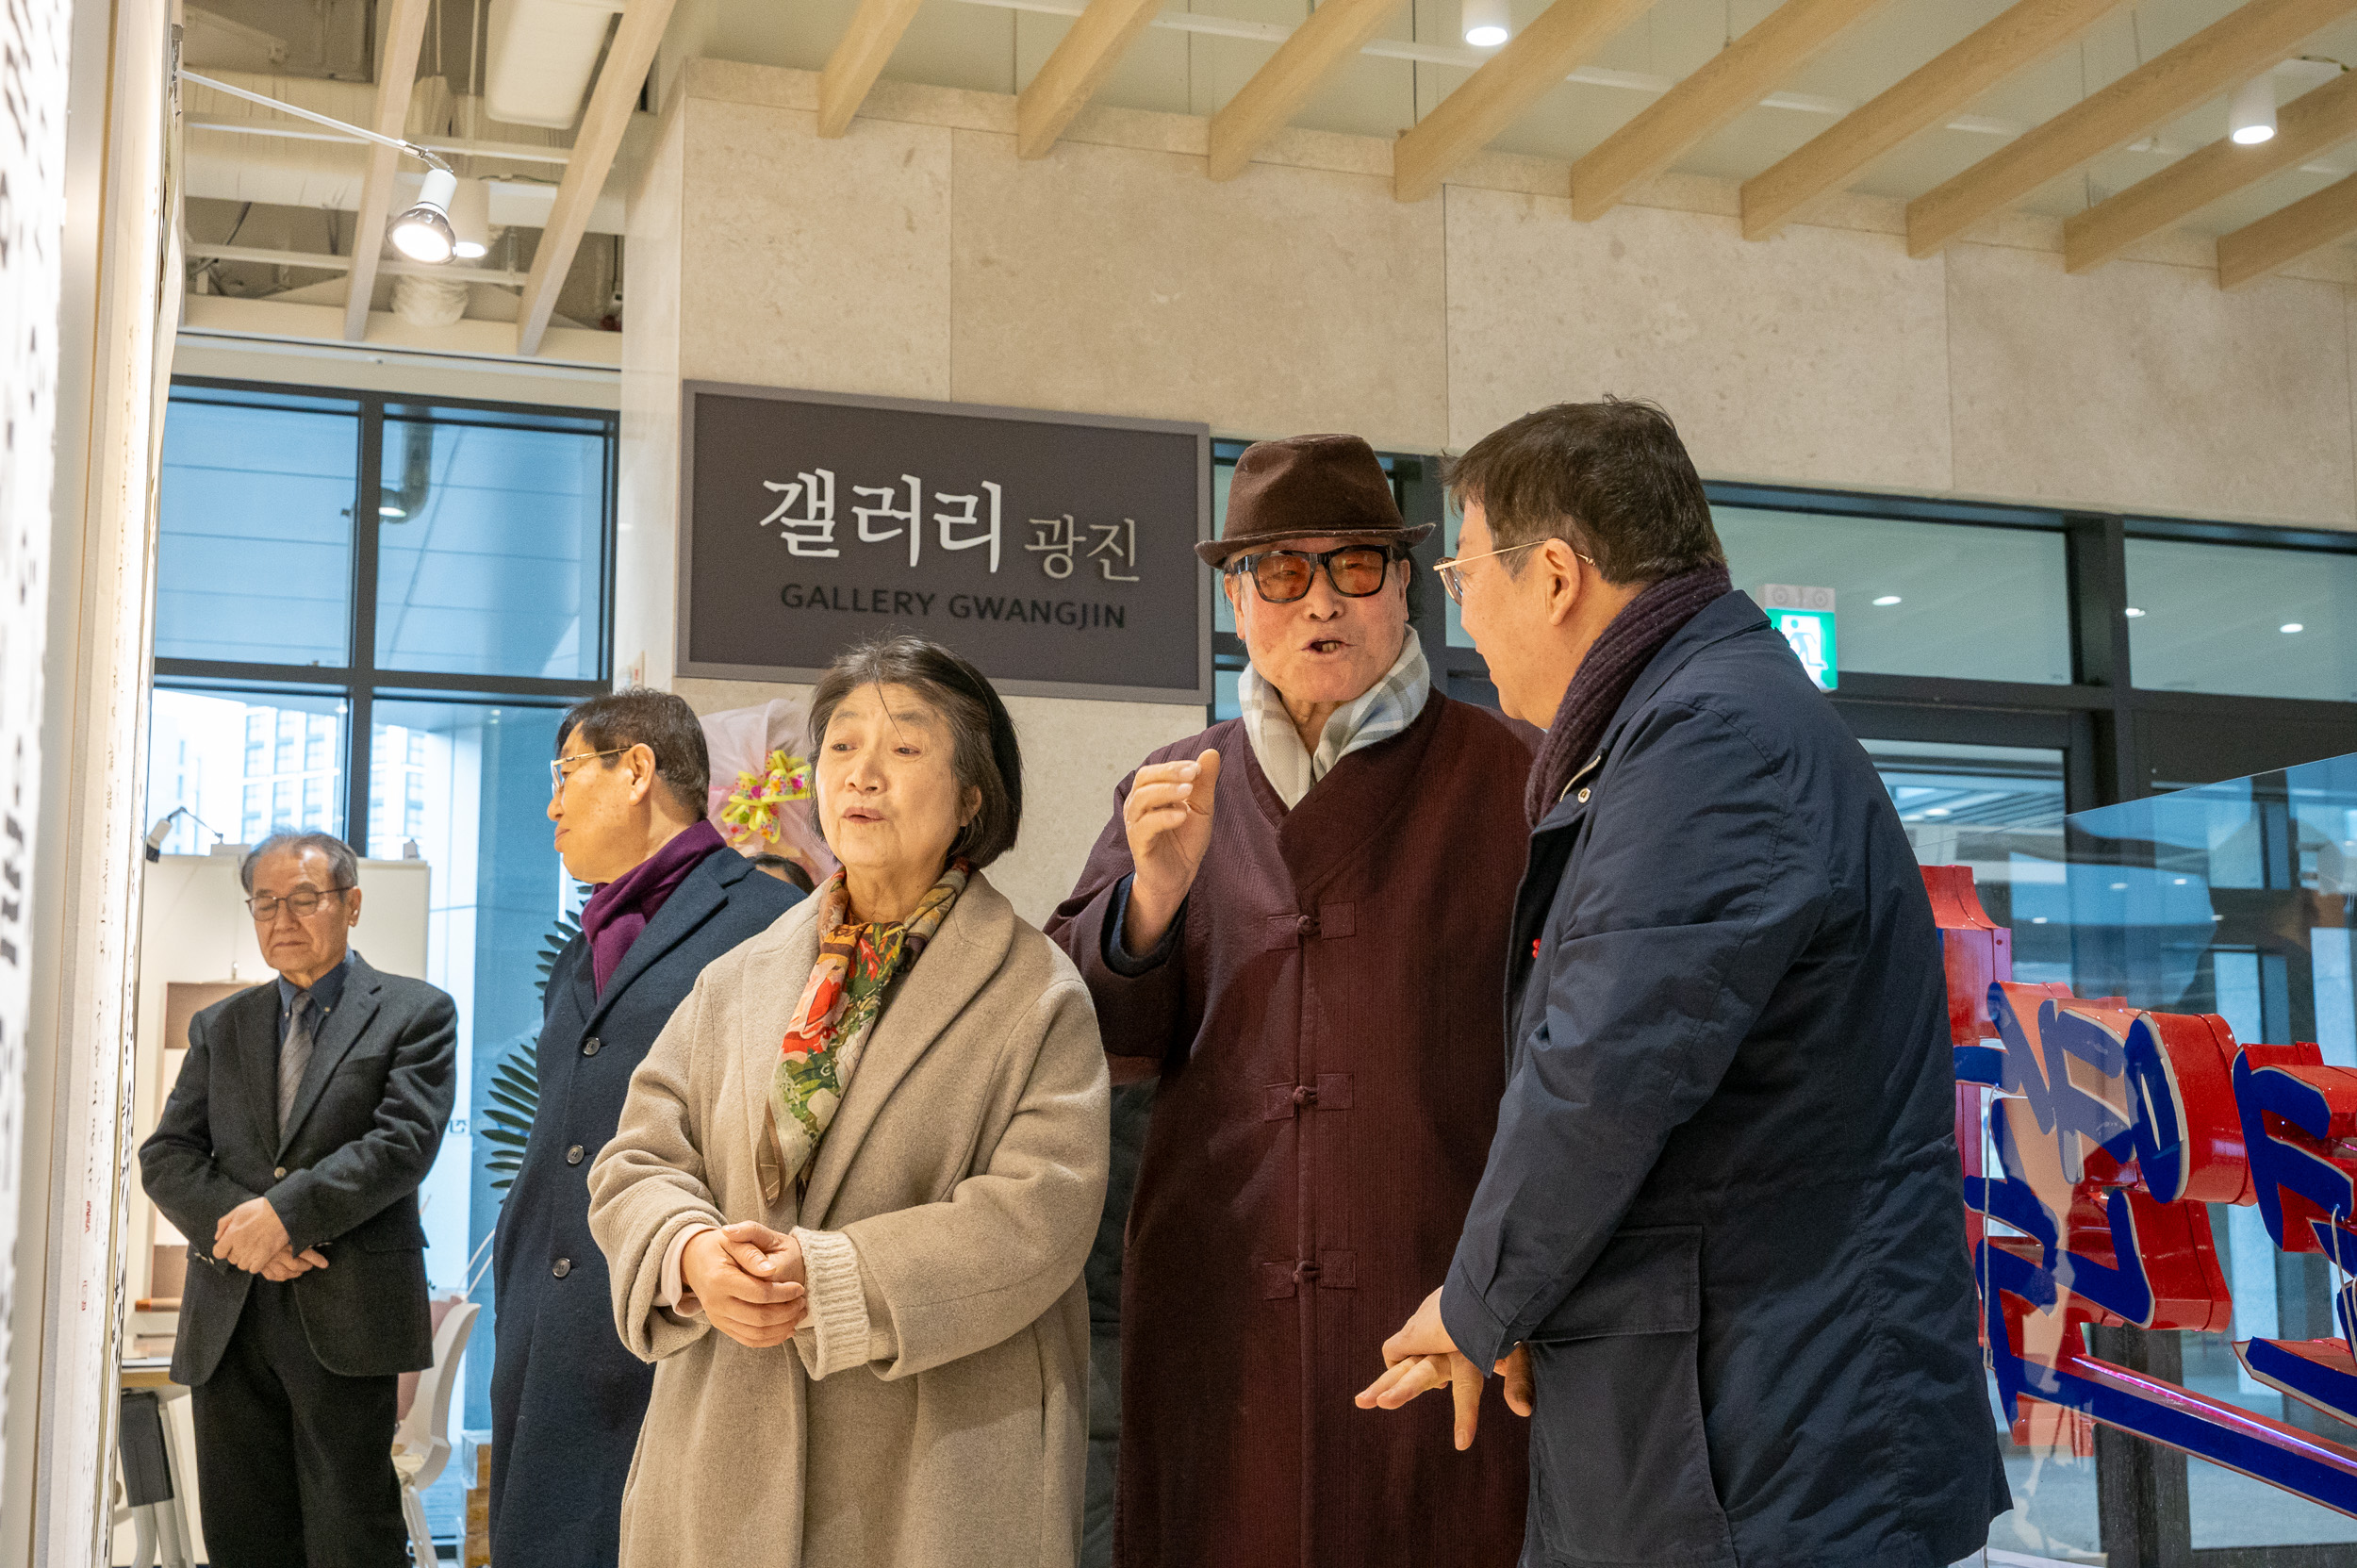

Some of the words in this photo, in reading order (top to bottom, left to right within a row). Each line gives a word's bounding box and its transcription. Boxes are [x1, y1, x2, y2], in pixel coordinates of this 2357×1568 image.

[760, 468, 1002, 573] 갤러리
[1024, 514, 1141, 582] 광진
[781, 583, 936, 616] GALLERY
[948, 594, 1126, 630] GWANGJIN
